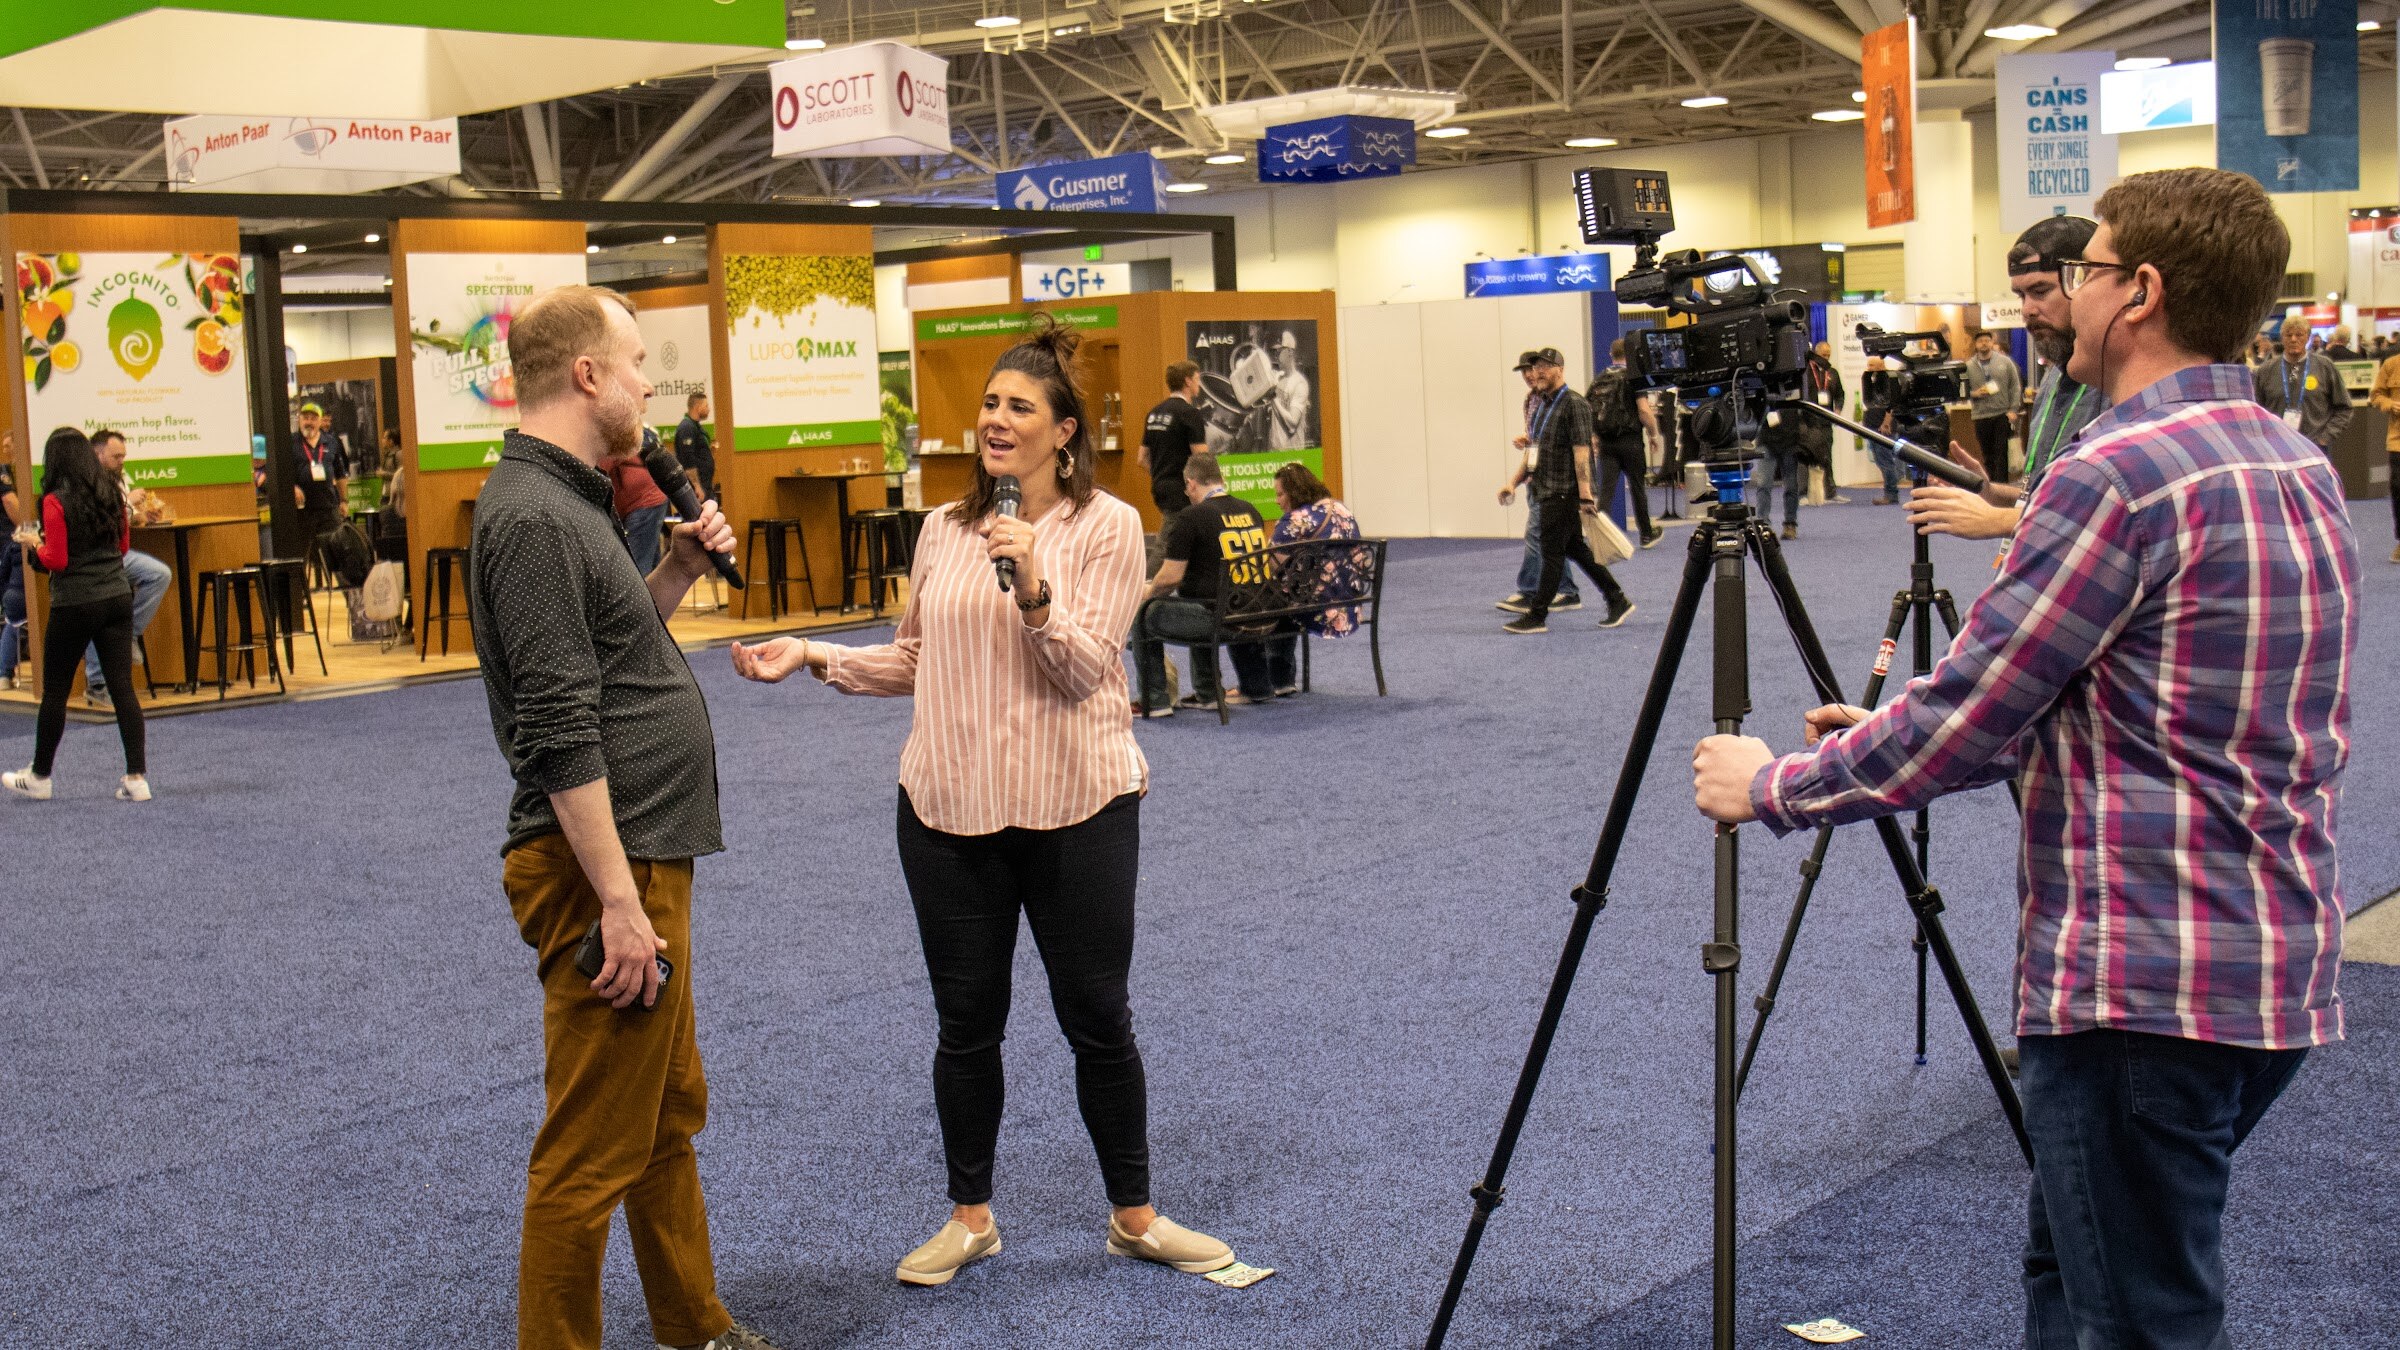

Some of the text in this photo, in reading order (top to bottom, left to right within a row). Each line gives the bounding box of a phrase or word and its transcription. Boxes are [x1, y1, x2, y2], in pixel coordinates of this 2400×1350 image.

[805, 73, 874, 110] SCOTT
[2026, 88, 2088, 108] CANS
[806, 103, 873, 125] LABORATORIES
[348, 121, 452, 144] Anton Paar
[2027, 115, 2088, 134] CASH
[205, 121, 270, 153] Anton Paar
[2028, 140, 2088, 160] EVERY SINGLE
[1049, 172, 1128, 198] Gusmer
[2028, 168, 2089, 195] RECYCLED
[1050, 196, 1108, 212] Enterprises,
[1471, 276, 1485, 285] The
[1508, 274, 1516, 283] of
[1517, 272, 1547, 284] brewing
[87, 271, 178, 308] INCOGNITO
[466, 284, 534, 296] SPECTRUM
[2000, 308, 2021, 317] GAM
[960, 320, 998, 332] Innovations
[1065, 313, 1099, 324] Showcase
[817, 340, 857, 358] MAX
[1208, 336, 1234, 345] HAAS
[432, 348, 483, 377] FULL
[451, 361, 513, 393] SPECT
[653, 379, 705, 397] rthHaas
[85, 415, 196, 431] Maximum hop flavor.
[138, 434, 176, 447] process
[179, 430, 200, 442] loss.
[803, 431, 832, 441] HAAS
[134, 467, 178, 480] HAAS
[1219, 466, 1231, 477] HE
[1233, 463, 1260, 476] TOOLS
[1262, 461, 1279, 474] YOU
[1231, 480, 1255, 492] BREW
[1256, 478, 1275, 490] YOU
[1221, 514, 1254, 527] LAGER
